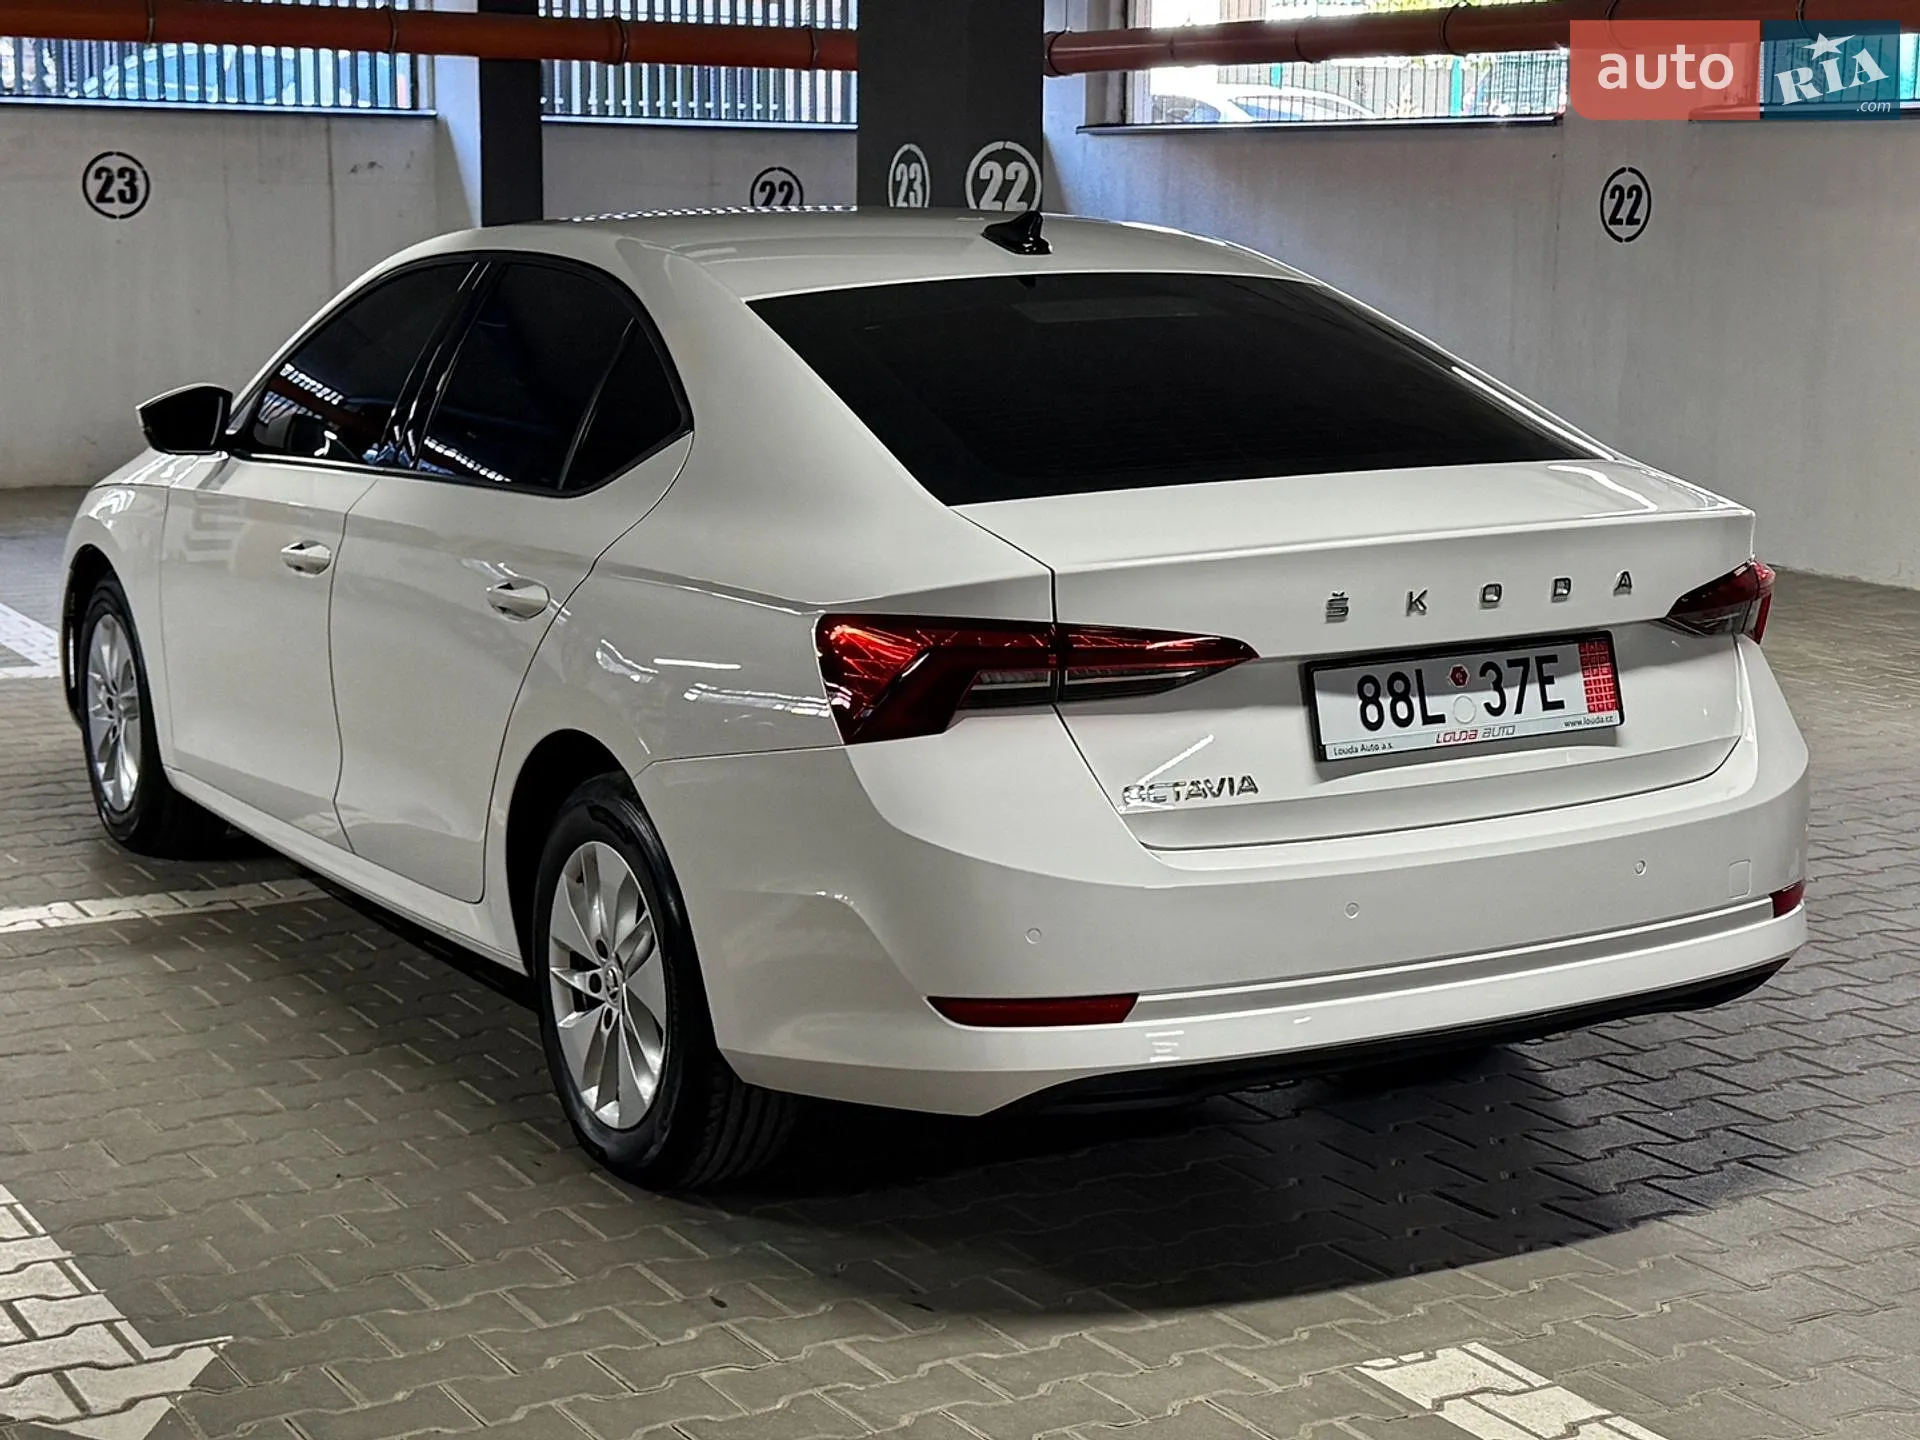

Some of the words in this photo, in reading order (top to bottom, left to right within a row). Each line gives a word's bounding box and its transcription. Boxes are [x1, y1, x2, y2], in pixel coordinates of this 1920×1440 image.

[94, 166, 138, 204] 23
[759, 180, 795, 207] 22
[895, 162, 923, 207] 23
[979, 160, 1030, 211] 22
[1608, 184, 1643, 226] 22
[1325, 570, 1633, 619] ŠKODA
[1357, 667, 1446, 732] 88L
[1479, 654, 1565, 717] 37E
[1122, 774, 1259, 805] OCTAVIA
